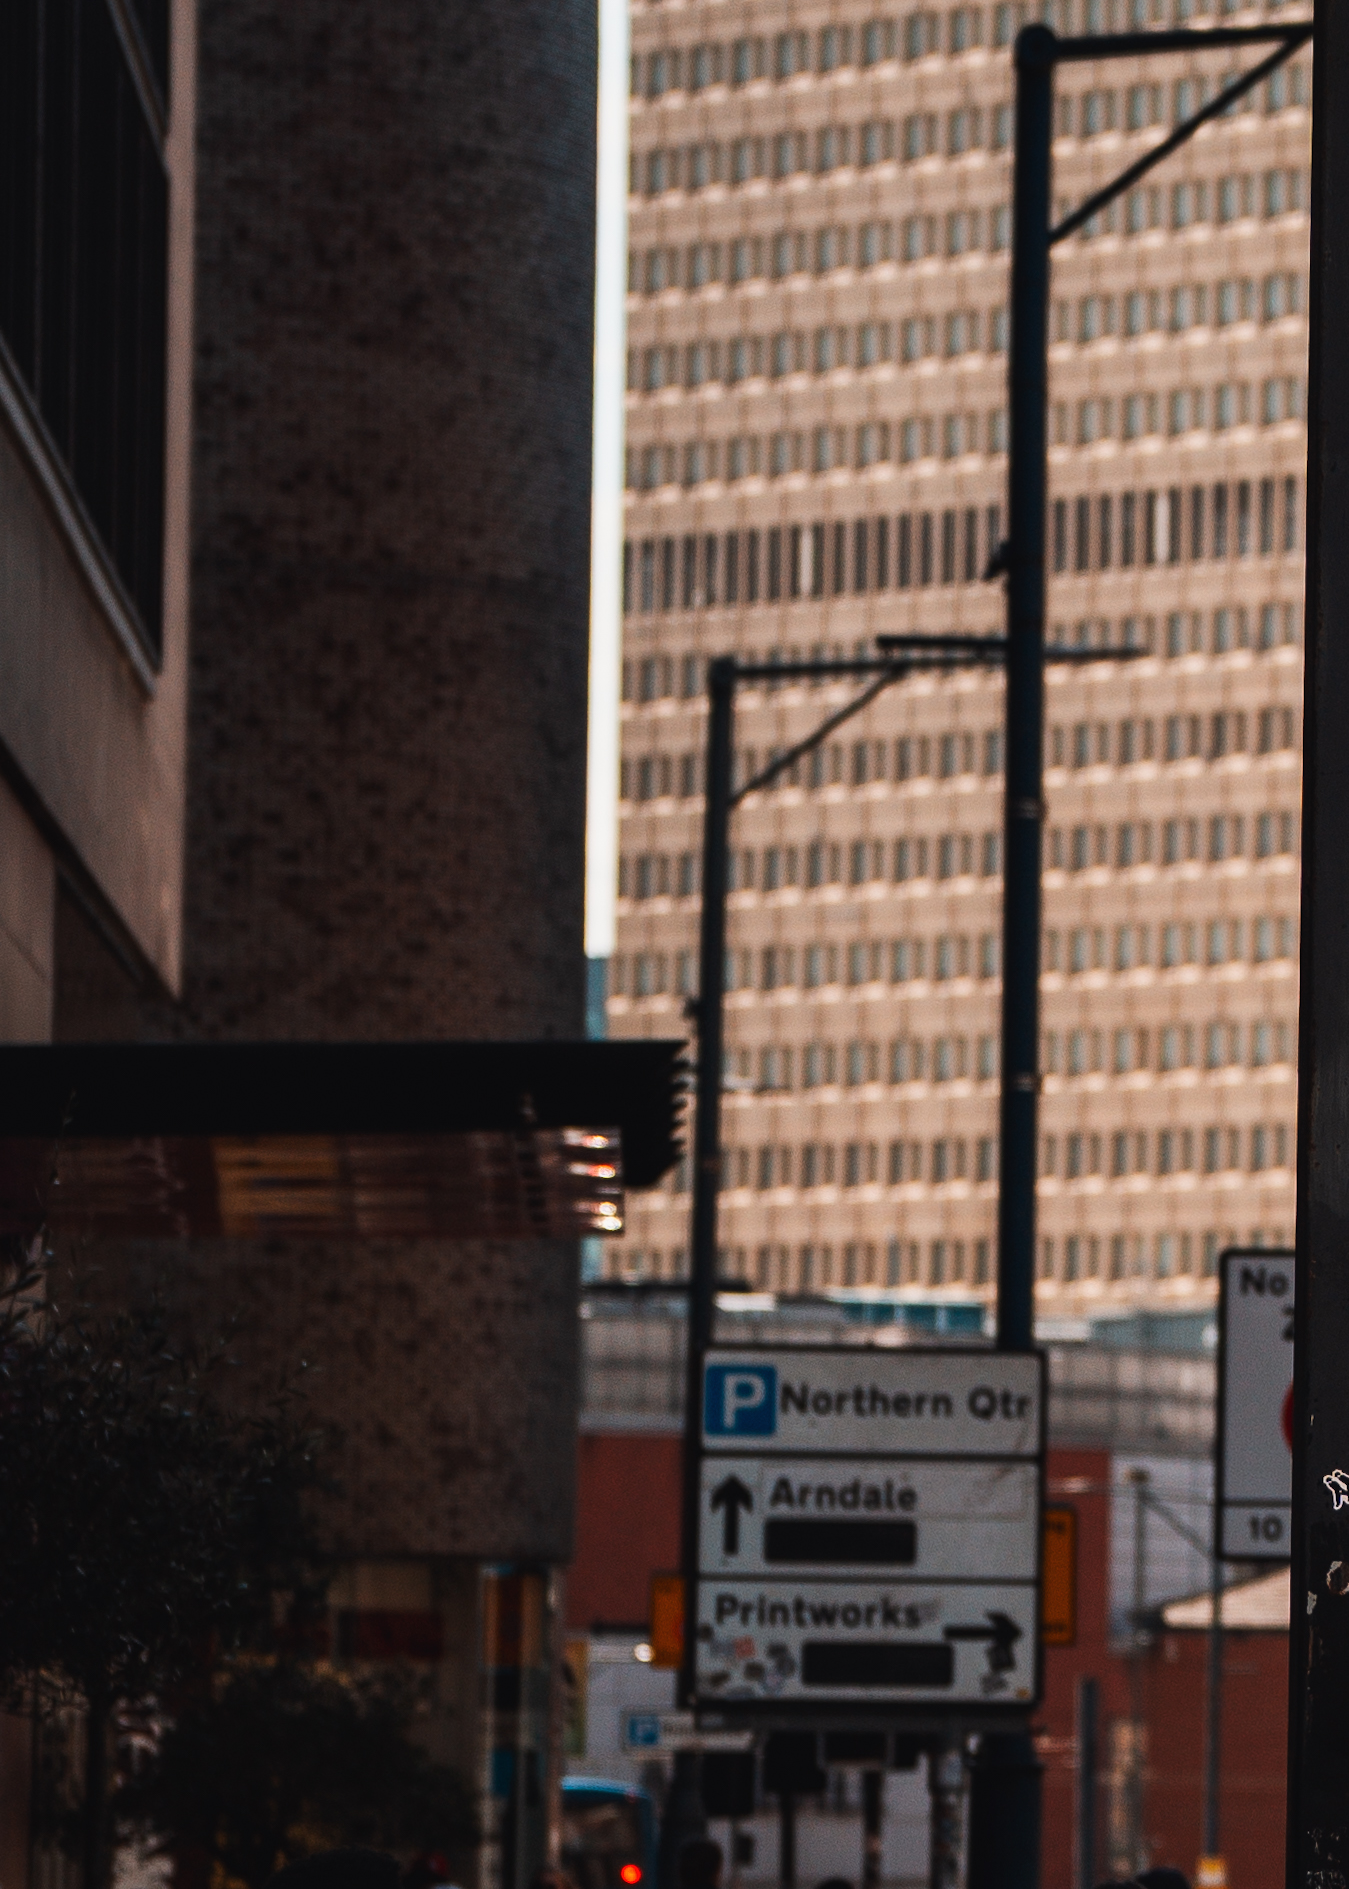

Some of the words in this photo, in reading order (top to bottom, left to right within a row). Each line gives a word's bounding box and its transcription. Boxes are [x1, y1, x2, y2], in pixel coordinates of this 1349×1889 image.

[1239, 1267, 1290, 1297] No
[723, 1372, 765, 1429] P
[780, 1383, 953, 1420] Northern
[966, 1384, 1033, 1421] Qtr
[768, 1475, 918, 1512] Arndale
[714, 1593, 923, 1630] Printworks
